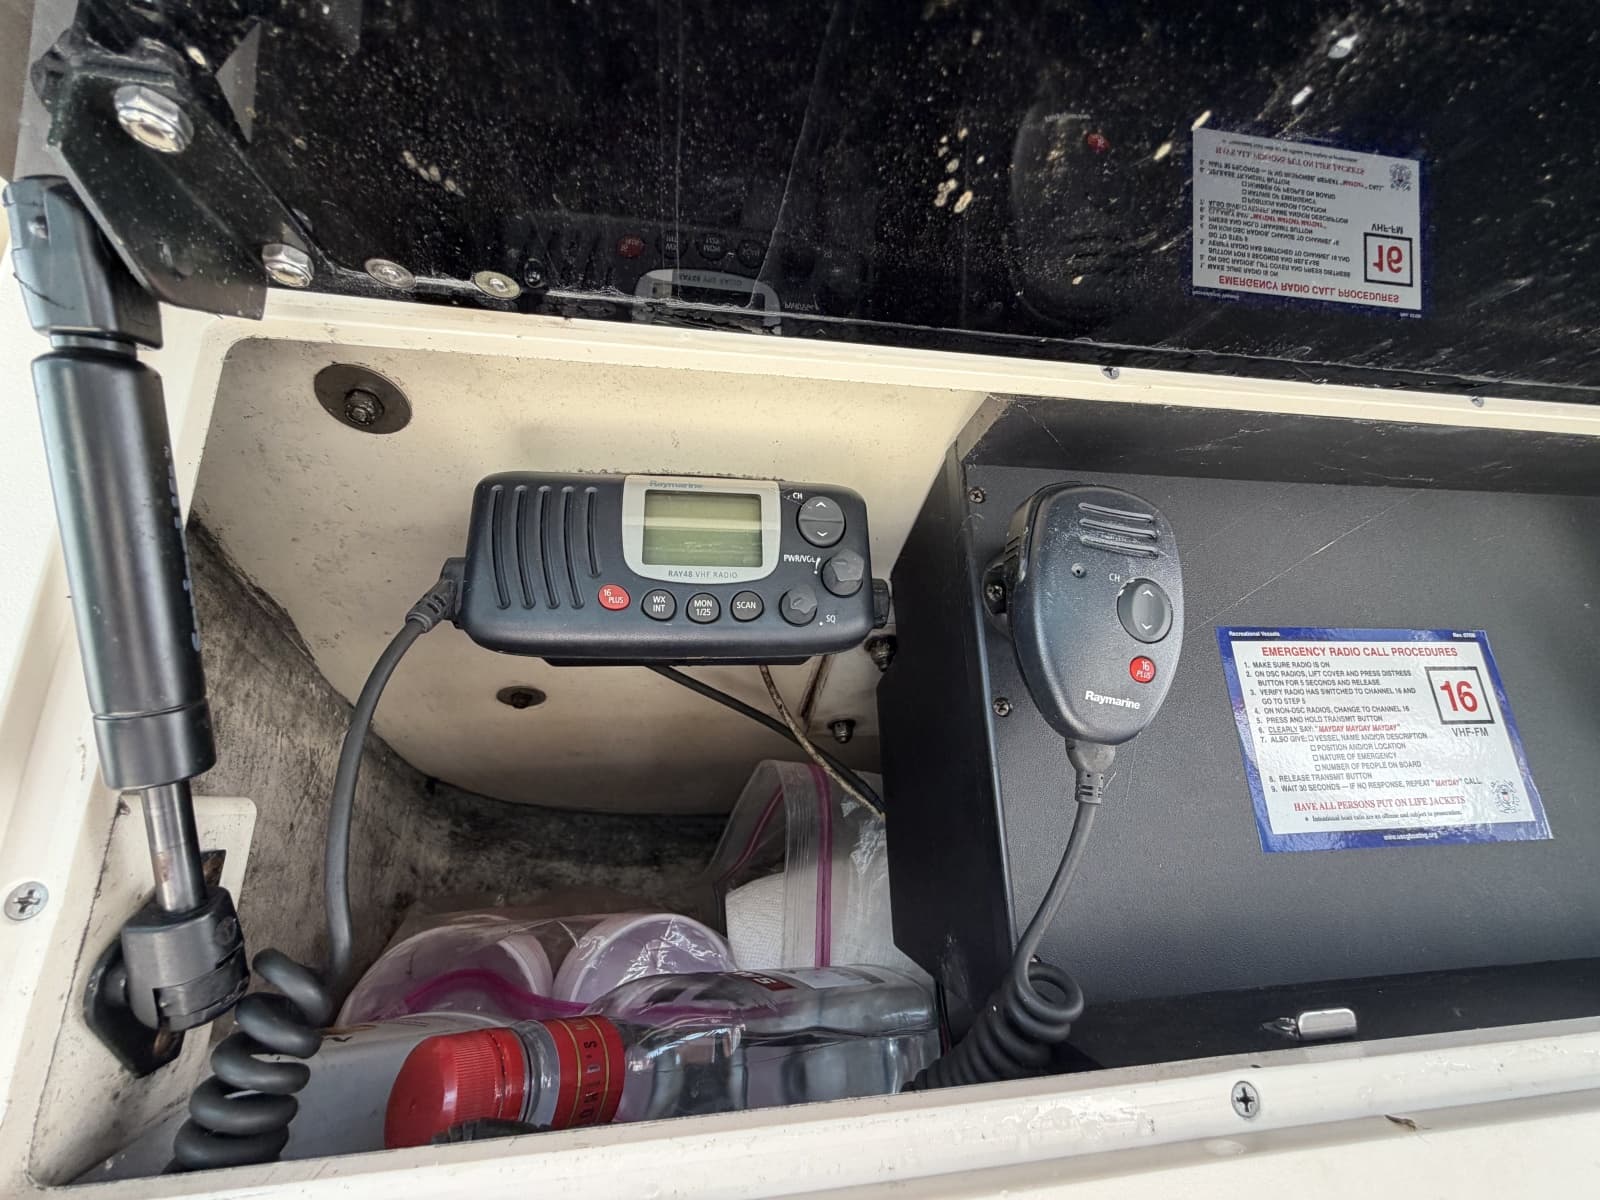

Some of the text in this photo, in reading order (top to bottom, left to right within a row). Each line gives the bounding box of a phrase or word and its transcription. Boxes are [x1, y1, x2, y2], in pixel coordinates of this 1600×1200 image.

[792, 491, 803, 501] CH
[668, 570, 738, 579] RAY48 VHF RADIO
[1109, 573, 1120, 583] CH
[603, 589, 612, 597] 16
[652, 595, 666, 604] WX
[694, 600, 713, 608] MON
[652, 604, 665, 613] INT
[736, 601, 756, 609] SCAN
[696, 608, 711, 616] 1/25
[825, 614, 837, 624] SQ
[1261, 647, 1458, 656] EMERGENCY RADIO CALL PROCEDURES
[1141, 660, 1150, 672] 16
[1085, 690, 1141, 709] Raymarine
[1439, 680, 1478, 713] 16
[1263, 707, 1274, 715] ON
[1370, 705, 1401, 713] CHANNEL
[1314, 734, 1340, 742] VESSEL
[1385, 732, 1428, 740] DESCRIPTION
[1451, 728, 1489, 737] VHF-FM
[1318, 753, 1346, 761] NATURE
[1356, 752, 1397, 760] EMERGENCY
[1321, 763, 1350, 771] NUMBER
[1278, 774, 1310, 782] RELEASE
[1310, 773, 1344, 781] TRANSMIT
[1307, 783, 1341, 791] SECONDS
[1348, 782, 1356, 790] IF
[1293, 795, 1466, 812] HAVE ALL PERSONS PUT ON LIFE JACKETS
